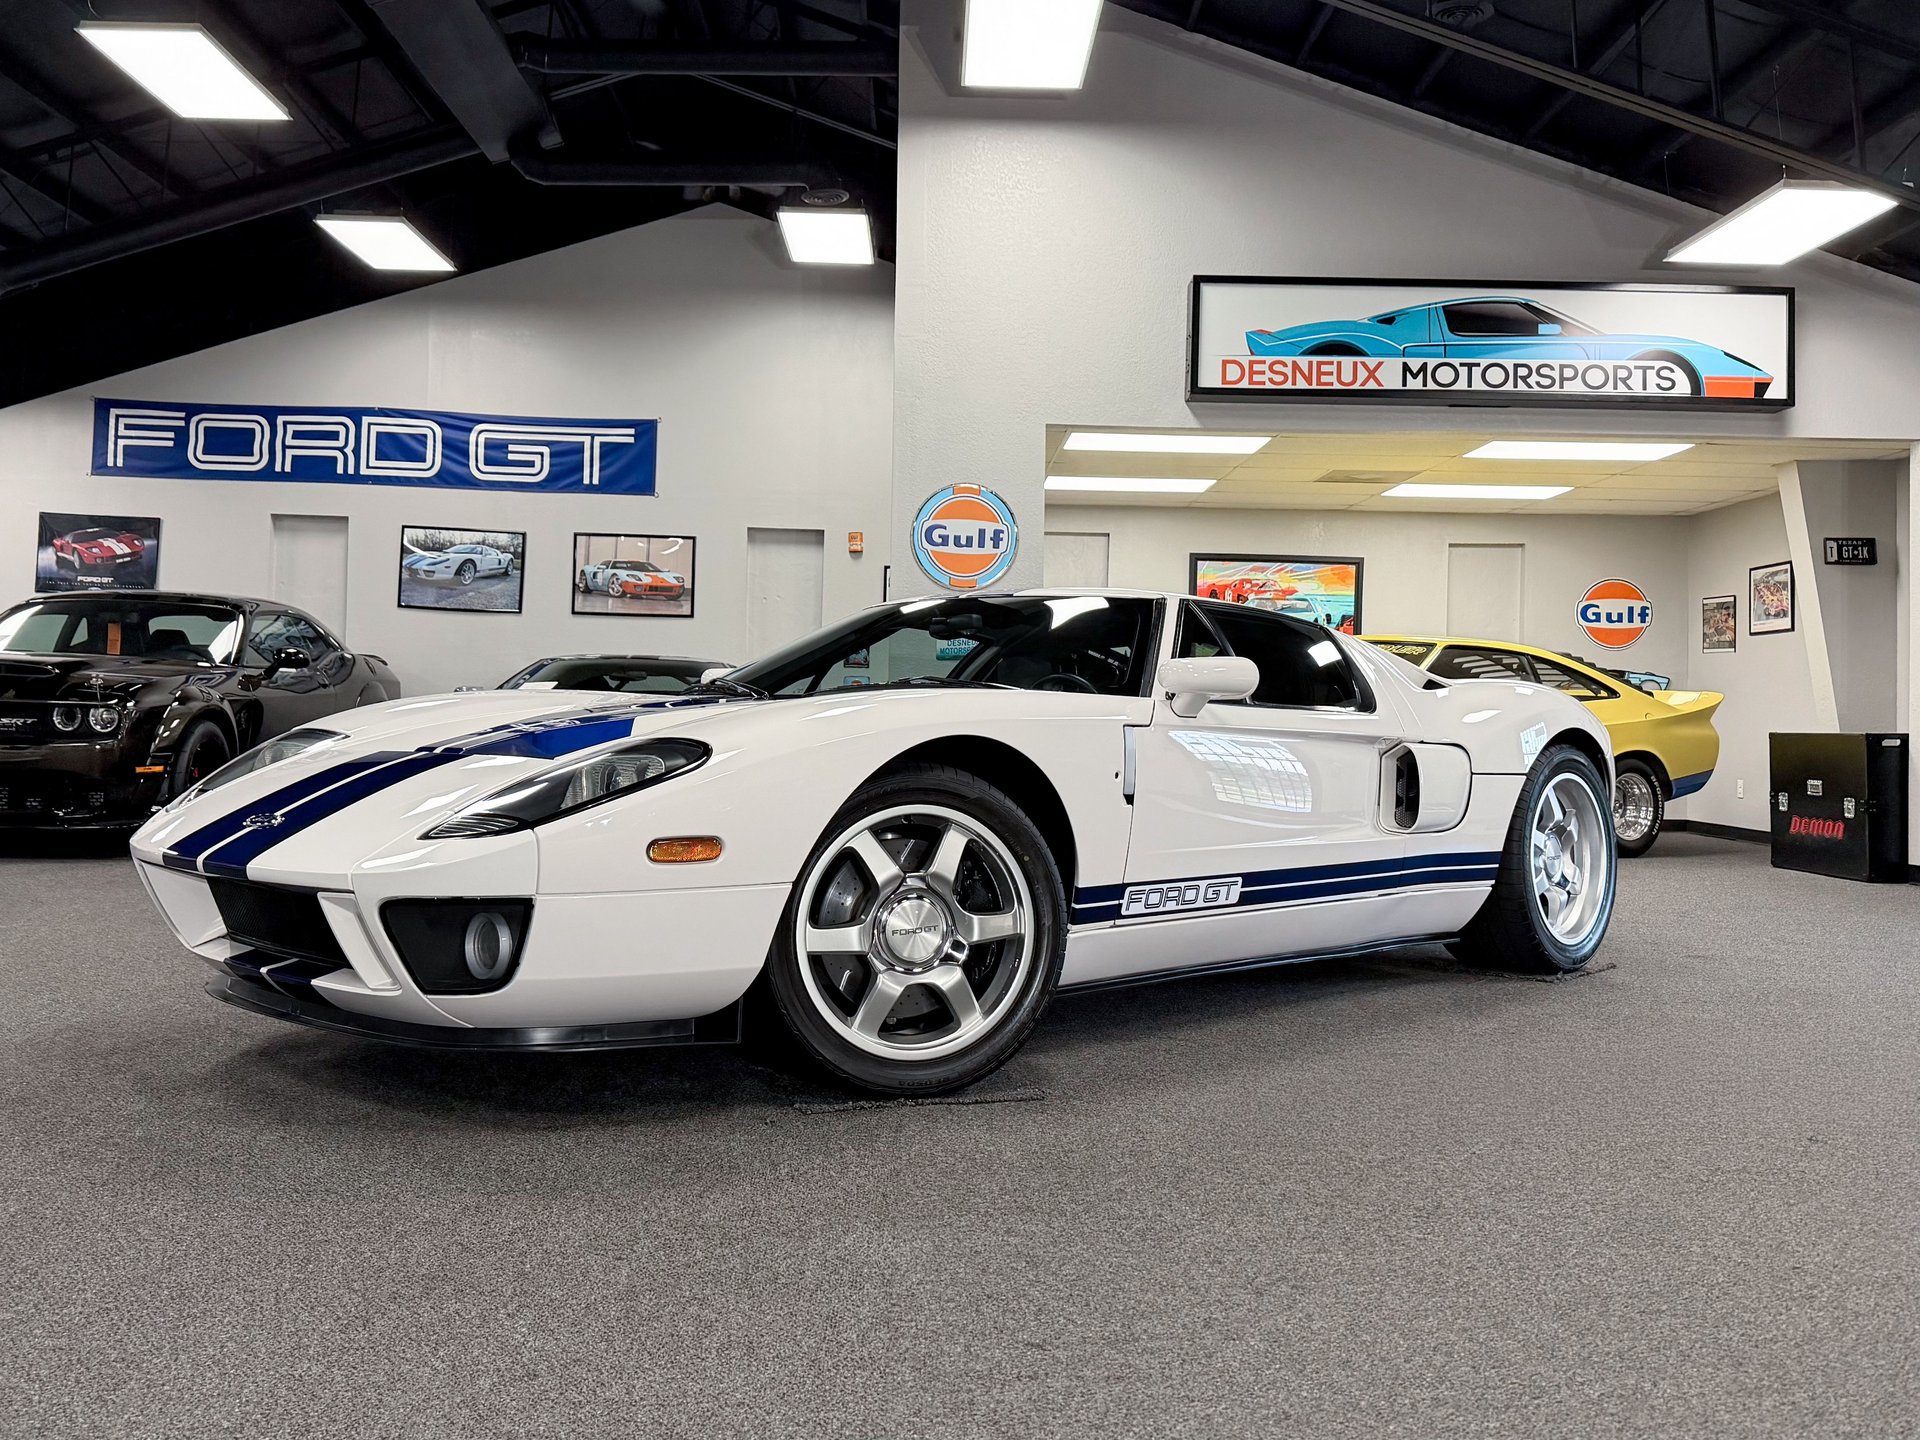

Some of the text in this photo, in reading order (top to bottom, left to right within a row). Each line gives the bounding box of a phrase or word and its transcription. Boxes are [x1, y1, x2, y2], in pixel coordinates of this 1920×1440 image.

[1220, 358, 1677, 392] DESNEUX MOTORSPORTS
[106, 407, 636, 486] FORD GT
[924, 523, 1005, 549] Gulf
[1579, 603, 1650, 624] Gulf
[0, 718, 38, 726] SRT
[1789, 814, 1846, 840] DEMON
[1125, 880, 1240, 910] FORD GT
[891, 924, 939, 937] FORD GT
